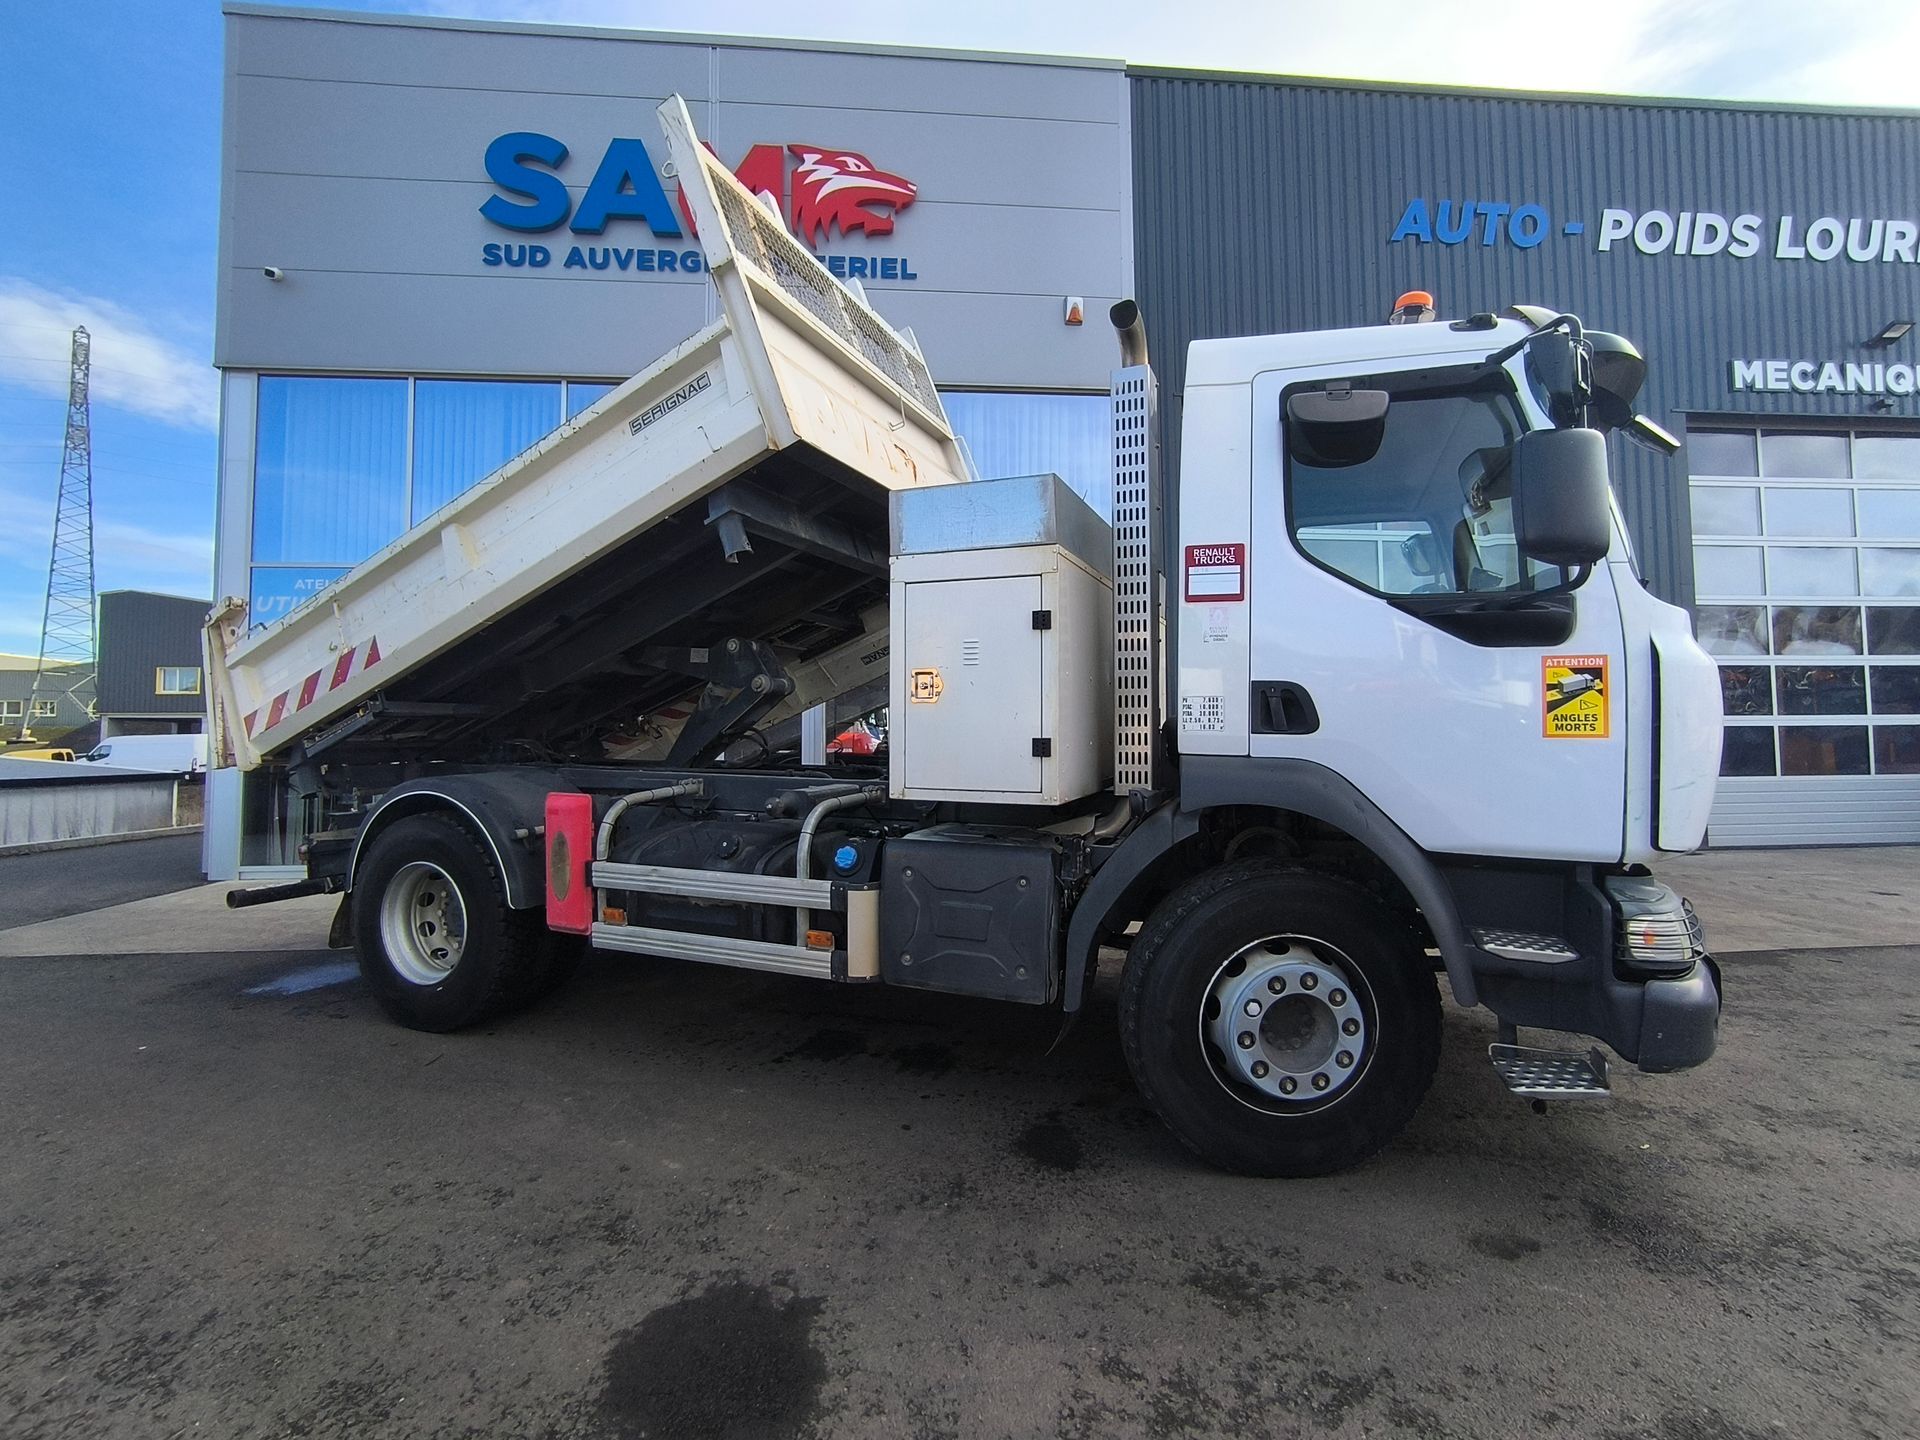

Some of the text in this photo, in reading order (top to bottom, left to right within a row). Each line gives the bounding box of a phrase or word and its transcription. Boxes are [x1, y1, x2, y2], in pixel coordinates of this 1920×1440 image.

[1390, 198, 1549, 248] AUTO
[1598, 208, 1762, 258] POIDS
[1775, 215, 1920, 263] LOUR
[482, 242, 551, 267] SUD
[564, 246, 705, 272] AUVERG
[1730, 358, 1920, 395] MECANIQ
[631, 374, 709, 433] SERIGNAC
[1193, 547, 1236, 557] RENAULT
[1193, 555, 1236, 565] TRUCKS
[1545, 657, 1603, 667] ATTENTION
[1552, 713, 1598, 722] ANGLES
[1555, 723, 1596, 732] MORTS
